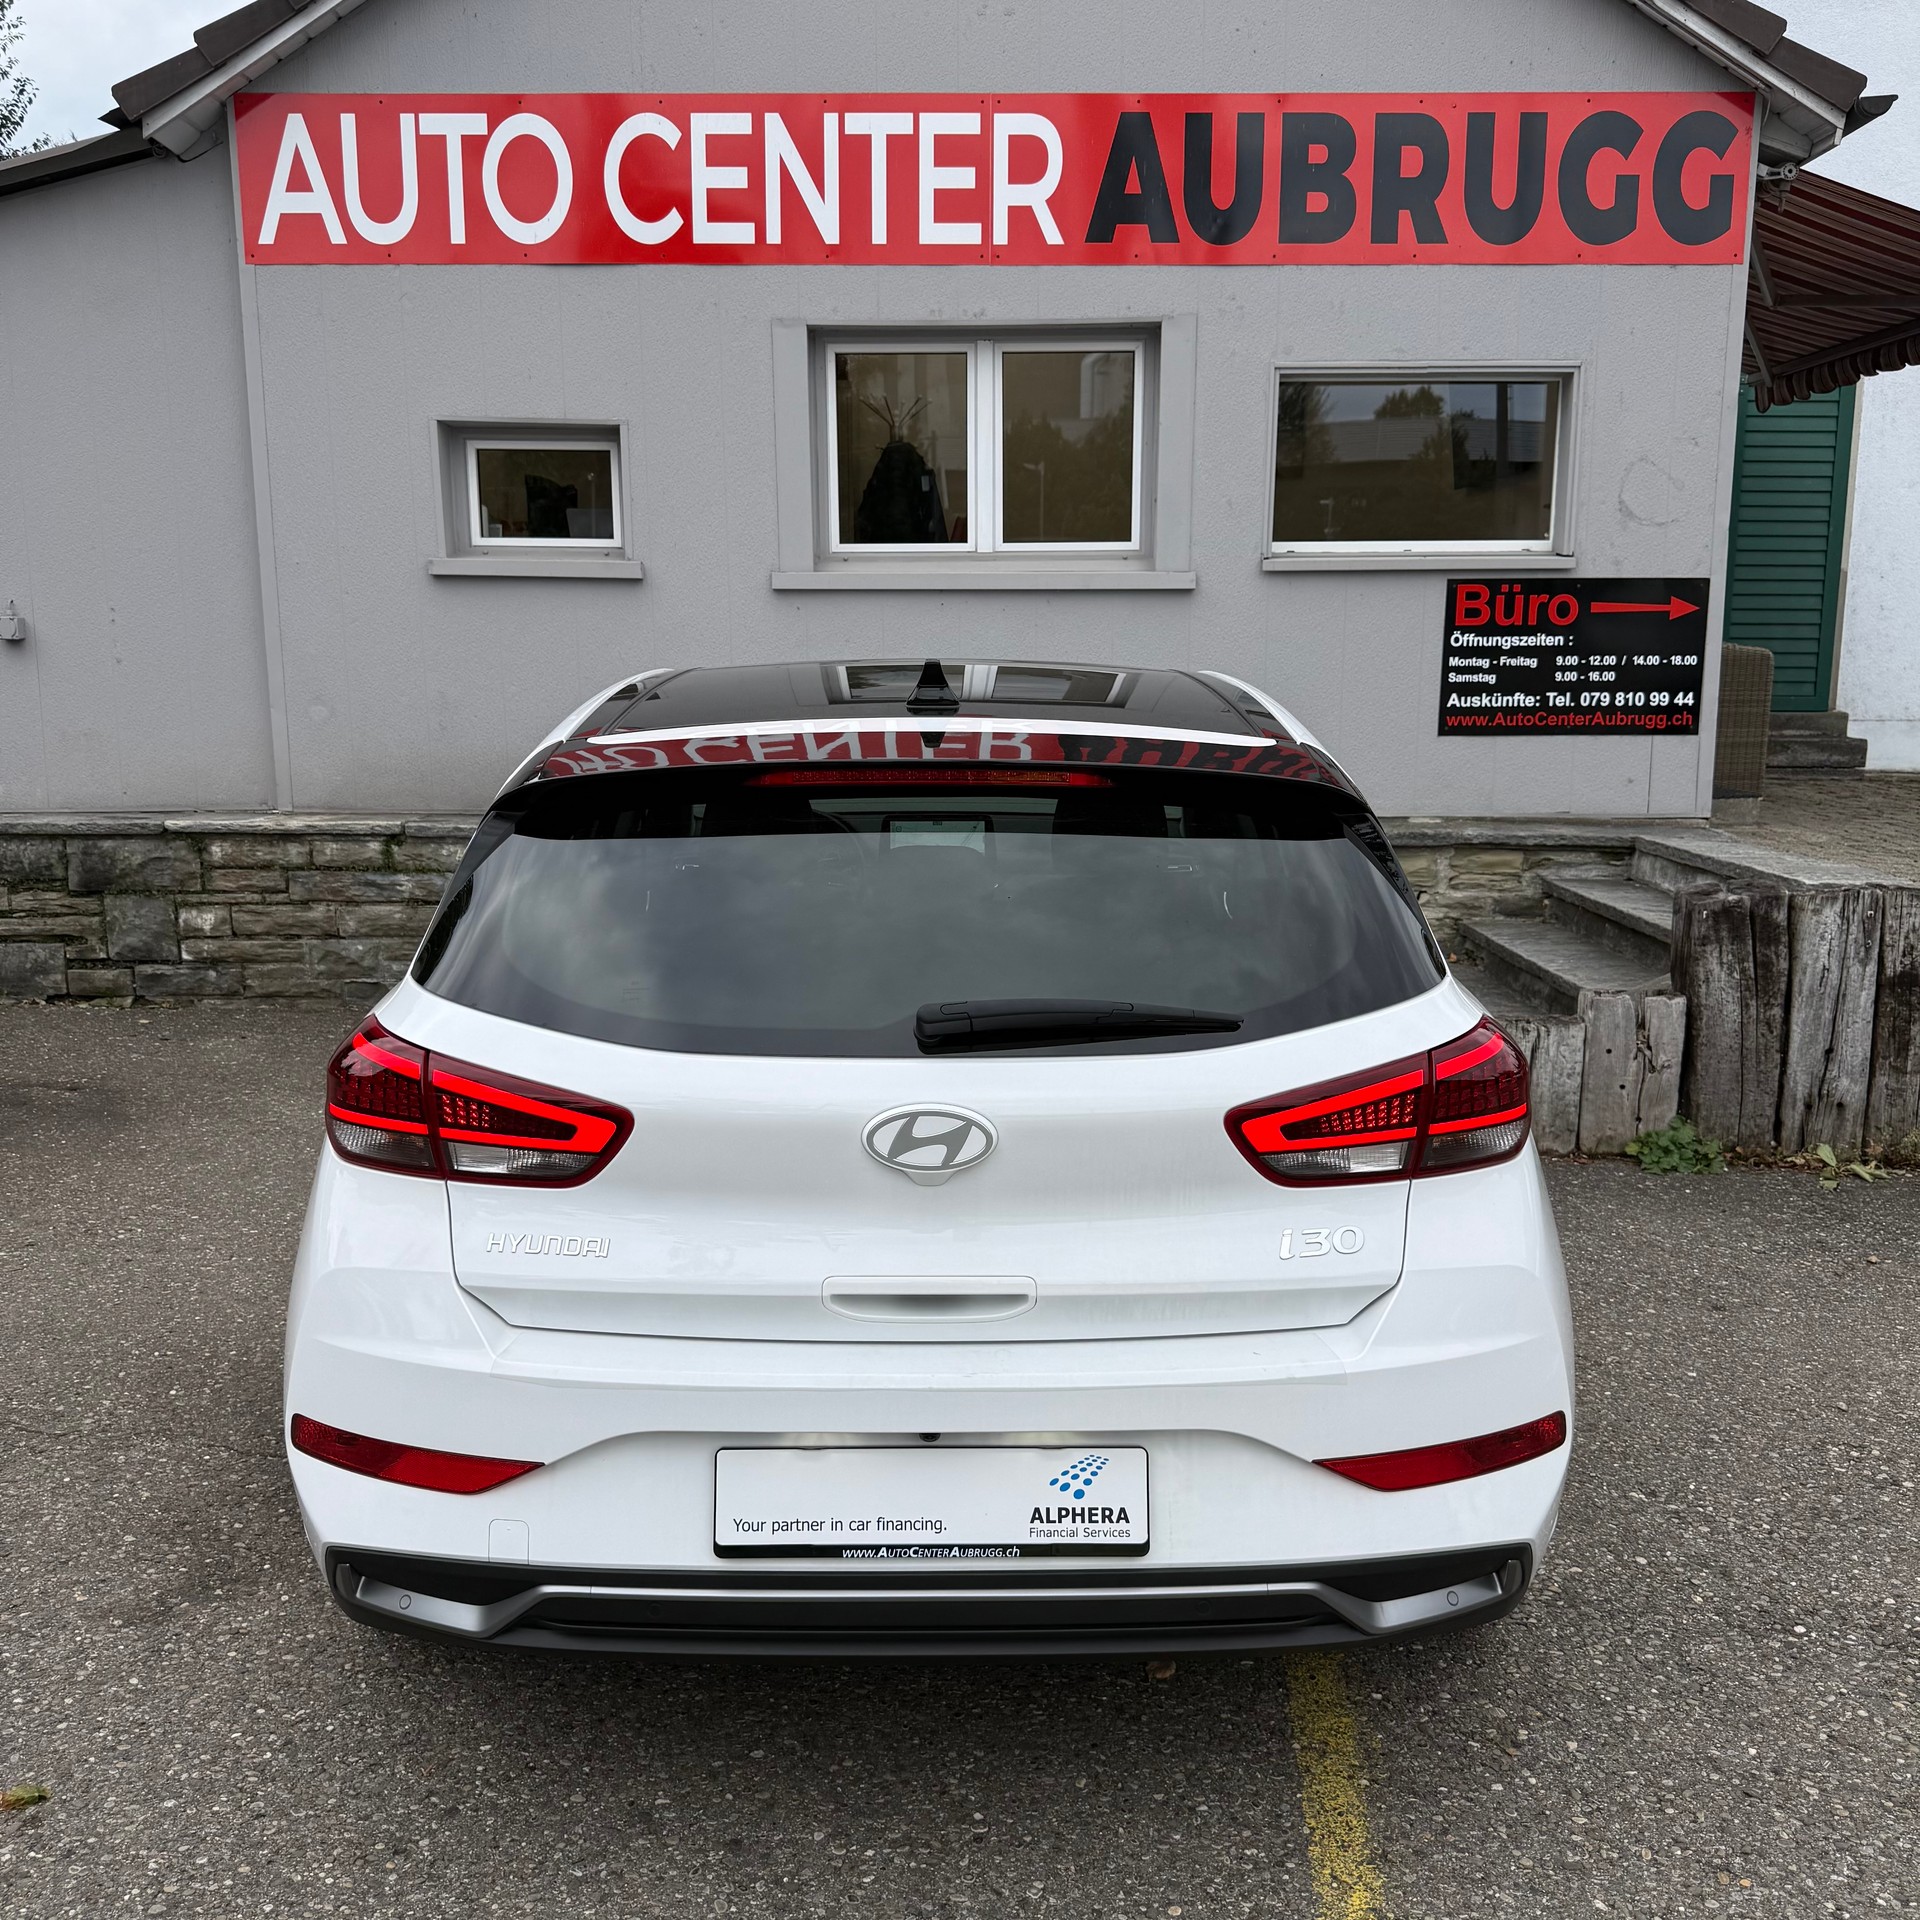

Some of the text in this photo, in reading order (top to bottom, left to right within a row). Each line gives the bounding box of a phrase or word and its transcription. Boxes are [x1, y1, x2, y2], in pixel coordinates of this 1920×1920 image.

[258, 110, 1739, 246] AUTO CENTER AUBRUGG
[1455, 584, 1579, 626] Büro
[1450, 631, 1564, 650] Öffnungszeiten
[1449, 657, 1490, 669] Montag
[1500, 655, 1538, 669] Freitag
[1555, 655, 1579, 667] 9.00
[1588, 655, 1617, 666] 12.00
[1632, 655, 1660, 666] 14.00
[1670, 655, 1698, 666] 18.00
[1448, 673, 1496, 685] Samstag
[1555, 671, 1578, 682] 9.00
[1587, 671, 1616, 682] 16.00
[1446, 692, 1694, 708] Auskünfte: Tel. 079 810 99 44
[1446, 711, 1693, 729] www.AutoCenterAubrugg.ch
[486, 1232, 611, 1259] HYUNDAI
[1279, 1225, 1366, 1261] i30
[1029, 1506, 1131, 1524] ALPHERA
[733, 1516, 948, 1535] Your partner in car financing.
[1029, 1527, 1131, 1538] Financial Services
